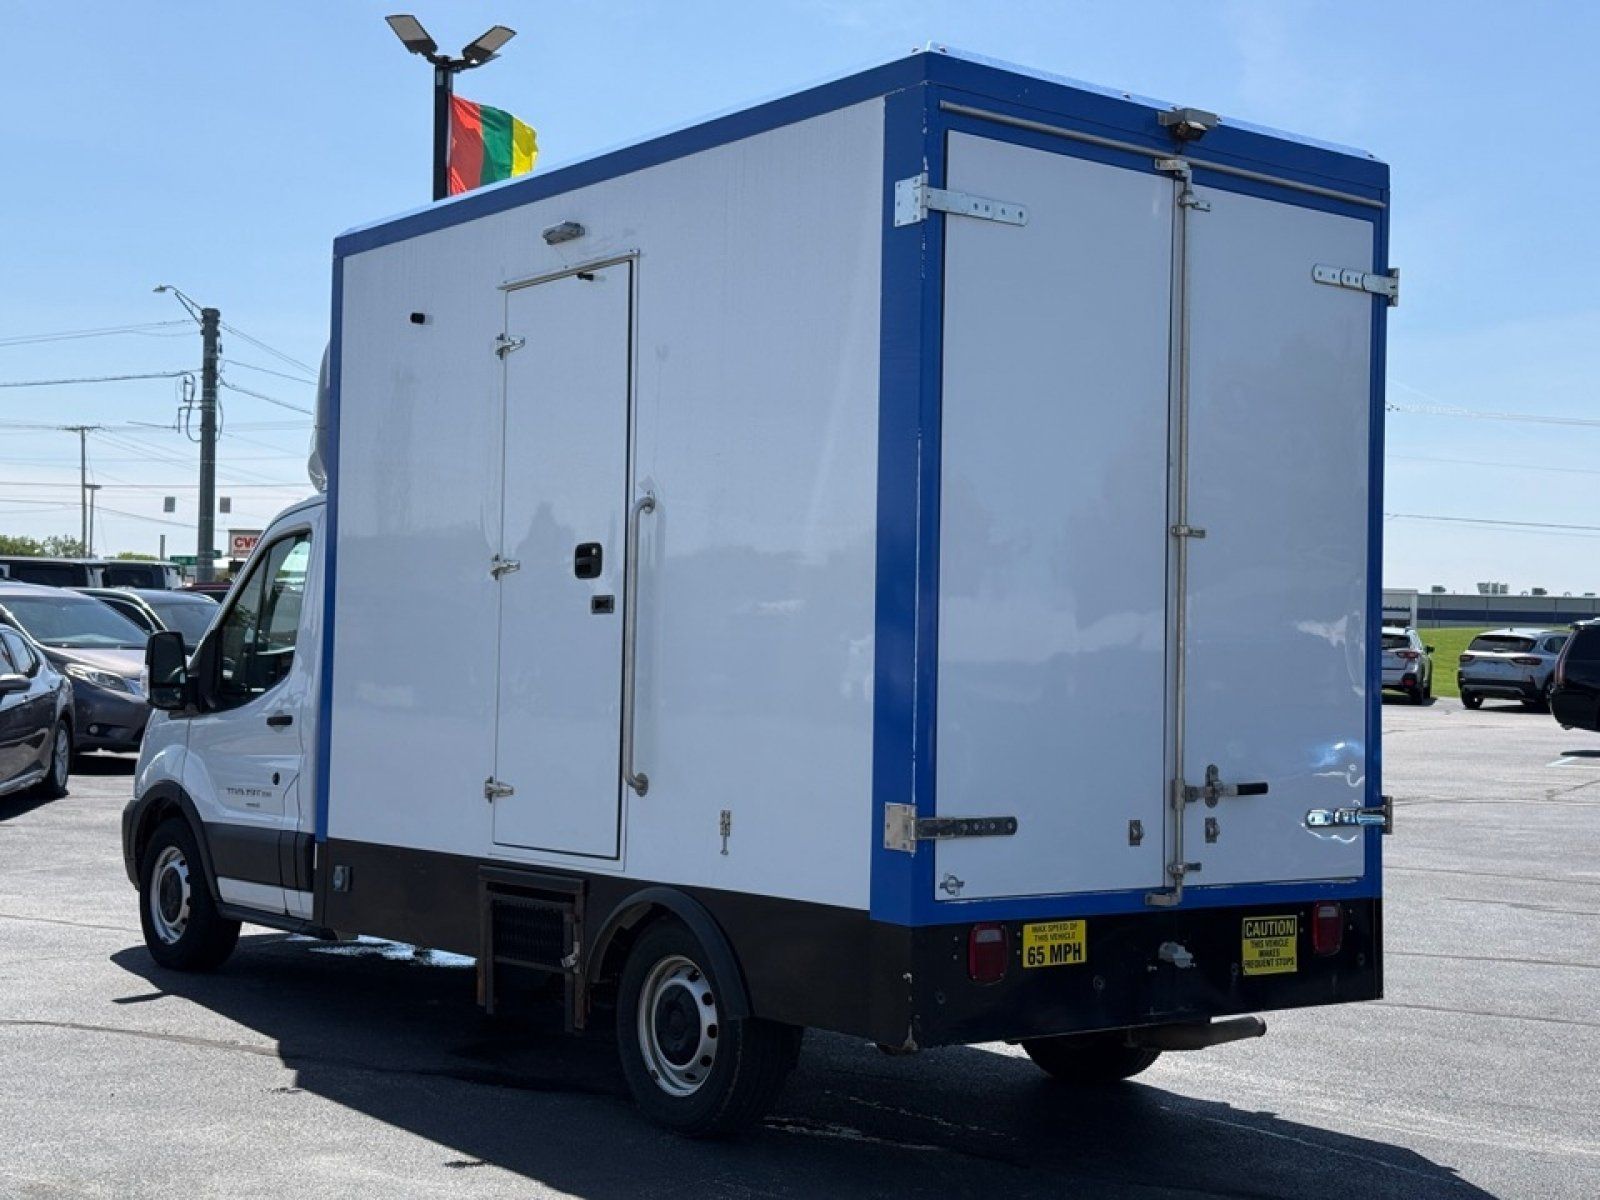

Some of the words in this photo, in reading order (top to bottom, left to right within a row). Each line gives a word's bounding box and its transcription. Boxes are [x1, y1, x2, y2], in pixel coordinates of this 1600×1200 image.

[1048, 923, 1069, 932] SPEED
[1246, 920, 1294, 937] CAUTION
[1034, 934, 1048, 942] THIS
[1050, 932, 1075, 940] VEHICLE
[1251, 940, 1264, 948] THIS
[1265, 938, 1289, 947] VEHICLE
[1028, 946, 1045, 965] 65
[1050, 943, 1081, 962] MPH
